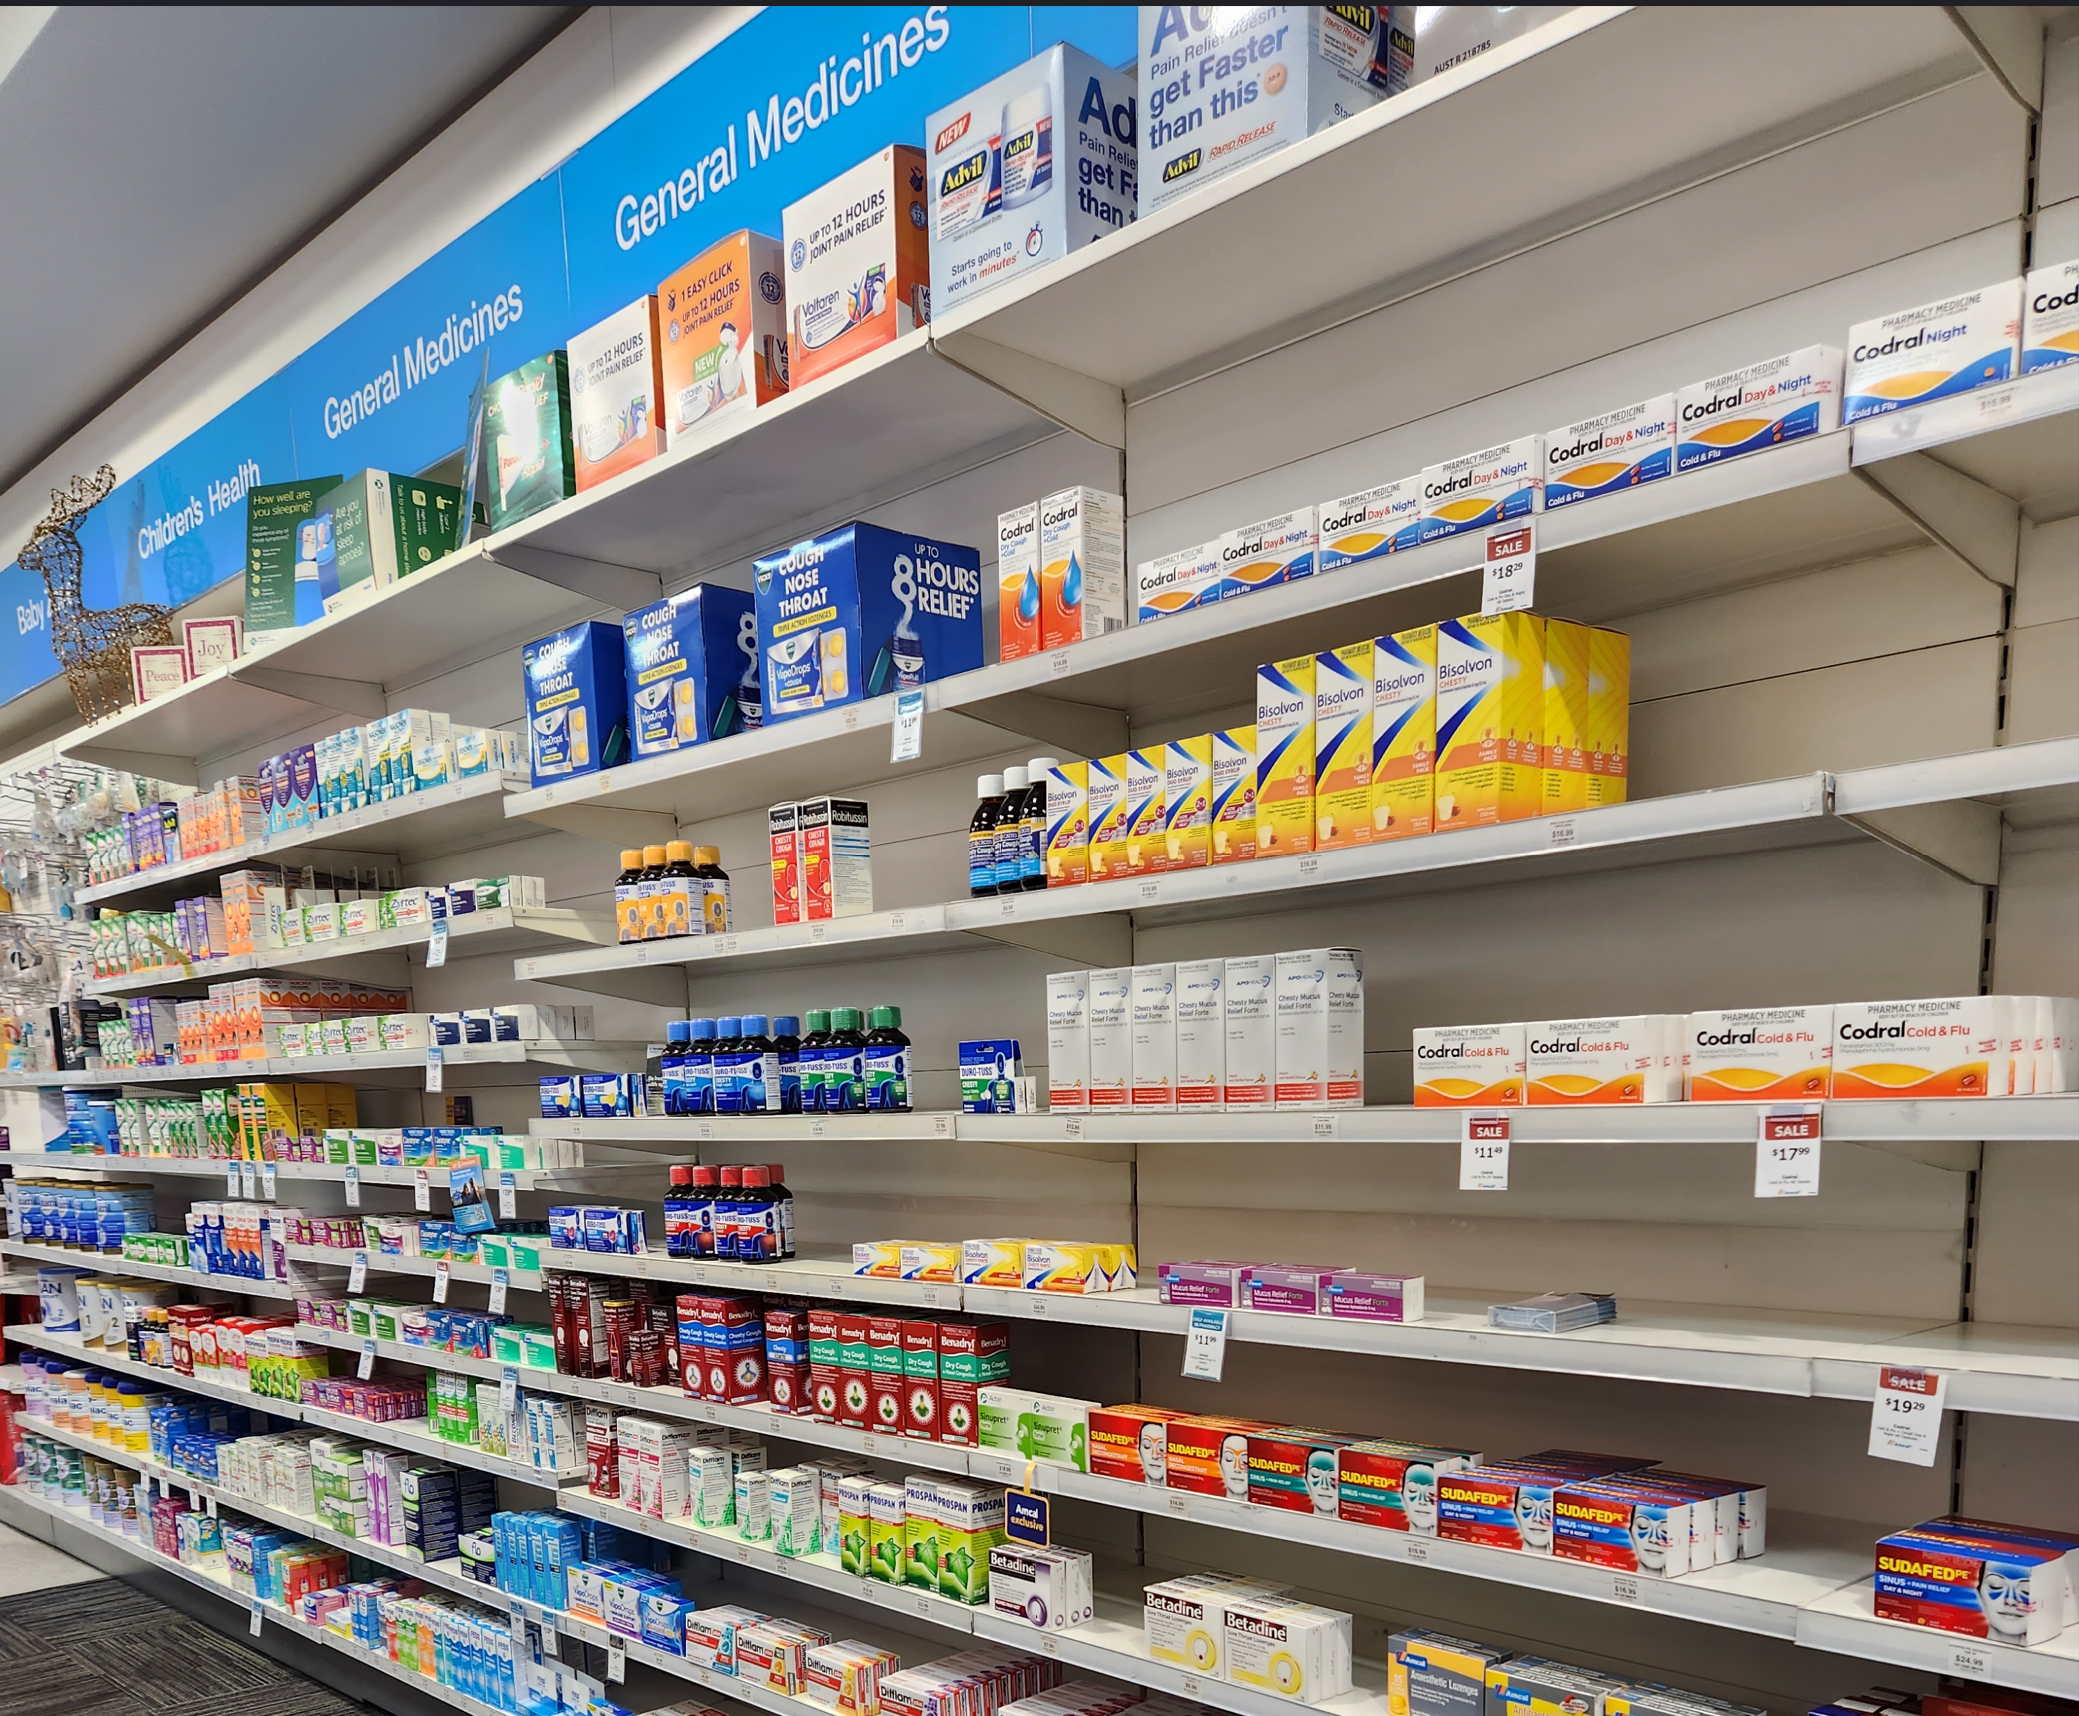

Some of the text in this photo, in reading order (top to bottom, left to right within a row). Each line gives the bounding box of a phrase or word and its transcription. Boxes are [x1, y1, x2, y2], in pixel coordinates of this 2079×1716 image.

[1151, 55, 1180, 80] Pain
[1434, 40, 1491, 75] AUST R 218785
[1150, 70, 1190, 119] get
[1199, 25, 1289, 89] Faster
[1149, 80, 1258, 150] than this
[615, 5, 949, 250] General Medicines
[938, 117, 967, 150] NEW
[1164, 121, 1276, 181] Advil RAPID RELEASE
[944, 154, 984, 194] Advil
[809, 189, 885, 245] UP TO 12 HOURS
[809, 239, 833, 264] JOINT
[834, 228, 854, 249] PAIN
[951, 240, 1012, 276] Starts going to
[681, 261, 733, 302] 1 EASY CLICK
[947, 276, 968, 293] work
[970, 271, 977, 282] in
[682, 279, 740, 322] UP TO 12 HOURS
[801, 290, 840, 318] Voltaren
[682, 322, 699, 338] JOINT
[699, 312, 713, 328] PAIN
[1854, 324, 1967, 363] Codral Night
[324, 284, 522, 439] General Medicines
[694, 356, 714, 373] NEW
[1705, 356, 1790, 391] PHARMACY MEDICINE
[1682, 387, 1743, 421] Codral
[1778, 374, 1811, 393] Night
[1680, 449, 1721, 468] Cold & Flu
[253, 490, 311, 505] How well are
[138, 459, 261, 559] Children's Health
[253, 501, 313, 519] you sleeping?
[335, 499, 360, 519] Are you
[1043, 502, 1078, 527] Codral
[336, 510, 362, 536] at risk of
[1043, 522, 1070, 537] Dry Cough
[337, 532, 354, 550] sleep
[915, 543, 939, 558] UP TO
[1495, 541, 1522, 556] SALE
[338, 541, 365, 567] apnoea?
[779, 545, 824, 576] COUGH
[757, 572, 772, 583] VICKS
[785, 568, 819, 595] NOSE
[916, 558, 979, 595] HOURS
[779, 587, 828, 618] THROAT
[16, 599, 44, 635] Baby
[777, 609, 832, 633] TRIPLE ACTION LOZENGES
[198, 639, 225, 660] Joy
[146, 669, 180, 682] Peace
[1439, 656, 1492, 680] Bisolvon
[1439, 677, 1467, 688] CHESTY
[1214, 756, 1247, 771] Bisolvon
[1224, 767, 1240, 775] SYRUP
[832, 810, 867, 824] Robitussin
[1278, 994, 1298, 1002] Chesty
[1278, 1002, 1293, 1010] Relief
[1868, 1001, 1961, 1014] PHARMACY MEDICINE
[1839, 1020, 1970, 1040] Codral Cold & Flu
[1477, 1127, 1502, 1137] SALE
[1775, 1124, 1809, 1137] SALE
[1334, 1295, 1389, 1307] Mucus Relief Forte
[941, 1336, 975, 1352] Benadryl
[945, 1359, 972, 1372] Dry Cough
[1890, 1375, 1926, 1391] SALE
[1168, 1442, 1208, 1458] SUDAFED
[1168, 1456, 1185, 1464] NASAL
[1168, 1462, 1208, 1474] DECONGESTANT
[404, 1478, 414, 1495] flo
[938, 1497, 967, 1514] PROSPAN
[1016, 1504, 1038, 1518] Amcal
[1011, 1516, 1044, 1533] exclusive
[990, 1552, 1035, 1575] Betadine
[1879, 1556, 1956, 1581] SUDAFED
[1879, 1575, 1906, 1586] SINUS
[1928, 1584, 1951, 1593] RELIEF
[1883, 1585, 1896, 1593] DAY
[1903, 1587, 1923, 1597] NIGHT
[1146, 1592, 1202, 1619] Betadine
[1405, 1657, 1426, 1667] Amcal
[1956, 1655, 1983, 1666] $24.99
[1410, 1669, 1447, 1688] Anaesthetic
[1448, 1681, 1479, 1697] Lozenges
